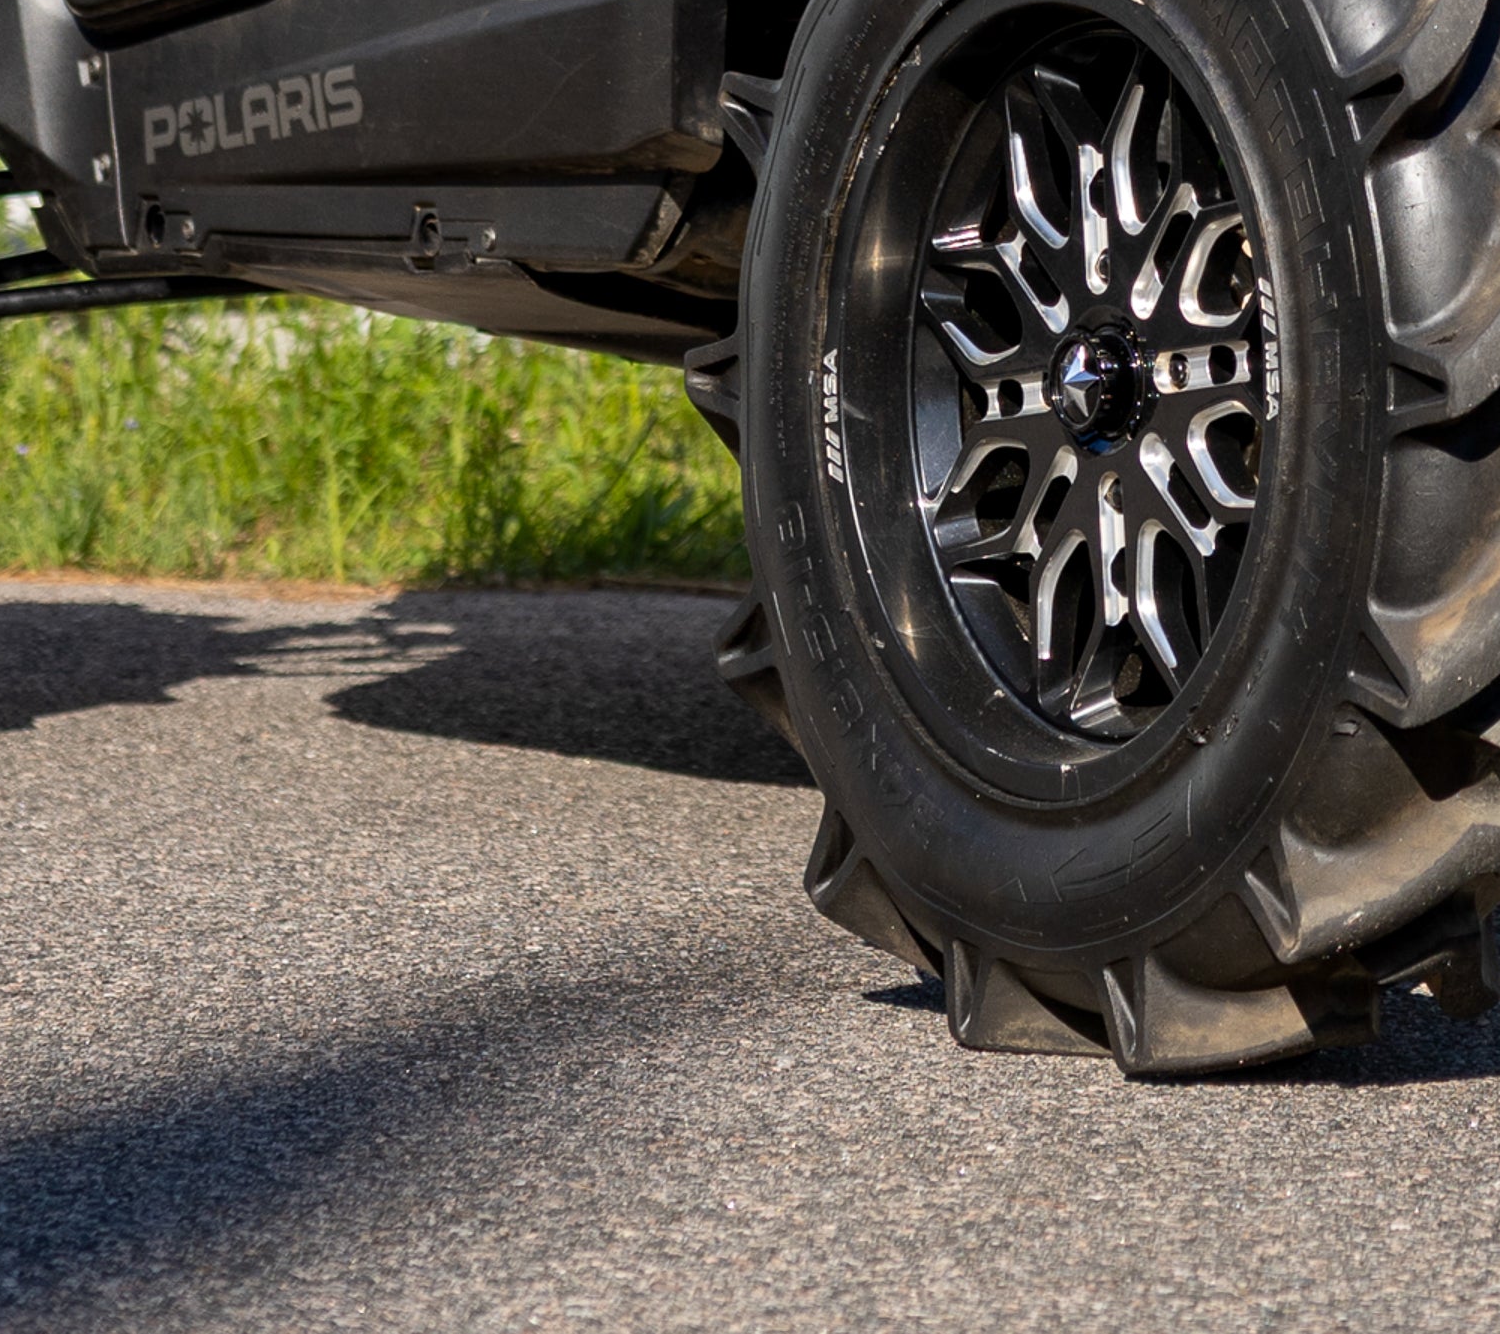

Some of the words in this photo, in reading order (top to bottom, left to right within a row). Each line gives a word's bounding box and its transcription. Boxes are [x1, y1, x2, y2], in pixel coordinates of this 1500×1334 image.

[144, 65, 363, 165] POLARIS
[823, 348, 839, 423] MSA
[1263, 341, 1279, 421] MSA
